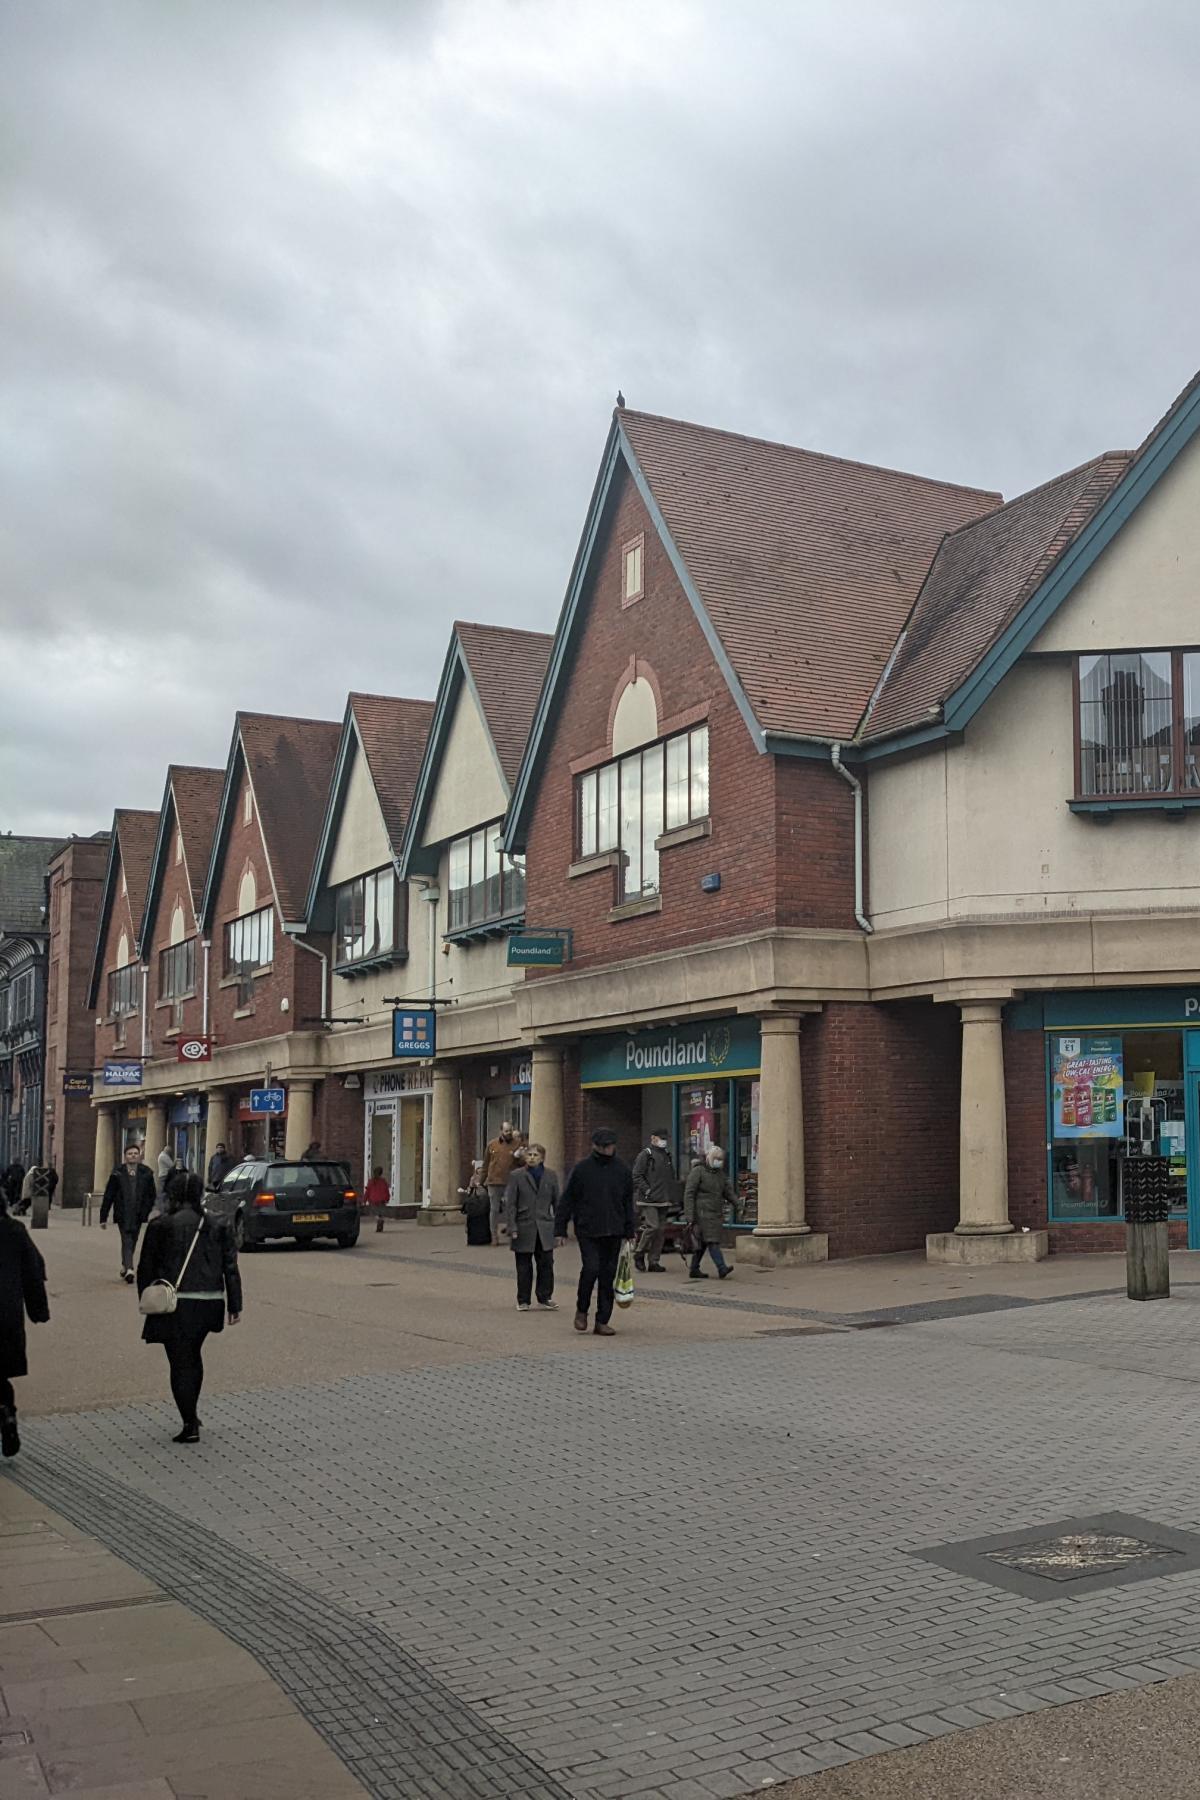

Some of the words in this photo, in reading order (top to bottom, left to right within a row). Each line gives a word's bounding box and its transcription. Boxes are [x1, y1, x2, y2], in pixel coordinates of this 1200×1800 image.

[511, 946, 552, 955] Poundland
[398, 1041, 431, 1049] GREGGS
[625, 1033, 707, 1070] Poundland
[380, 1072, 406, 1093] PHONE
